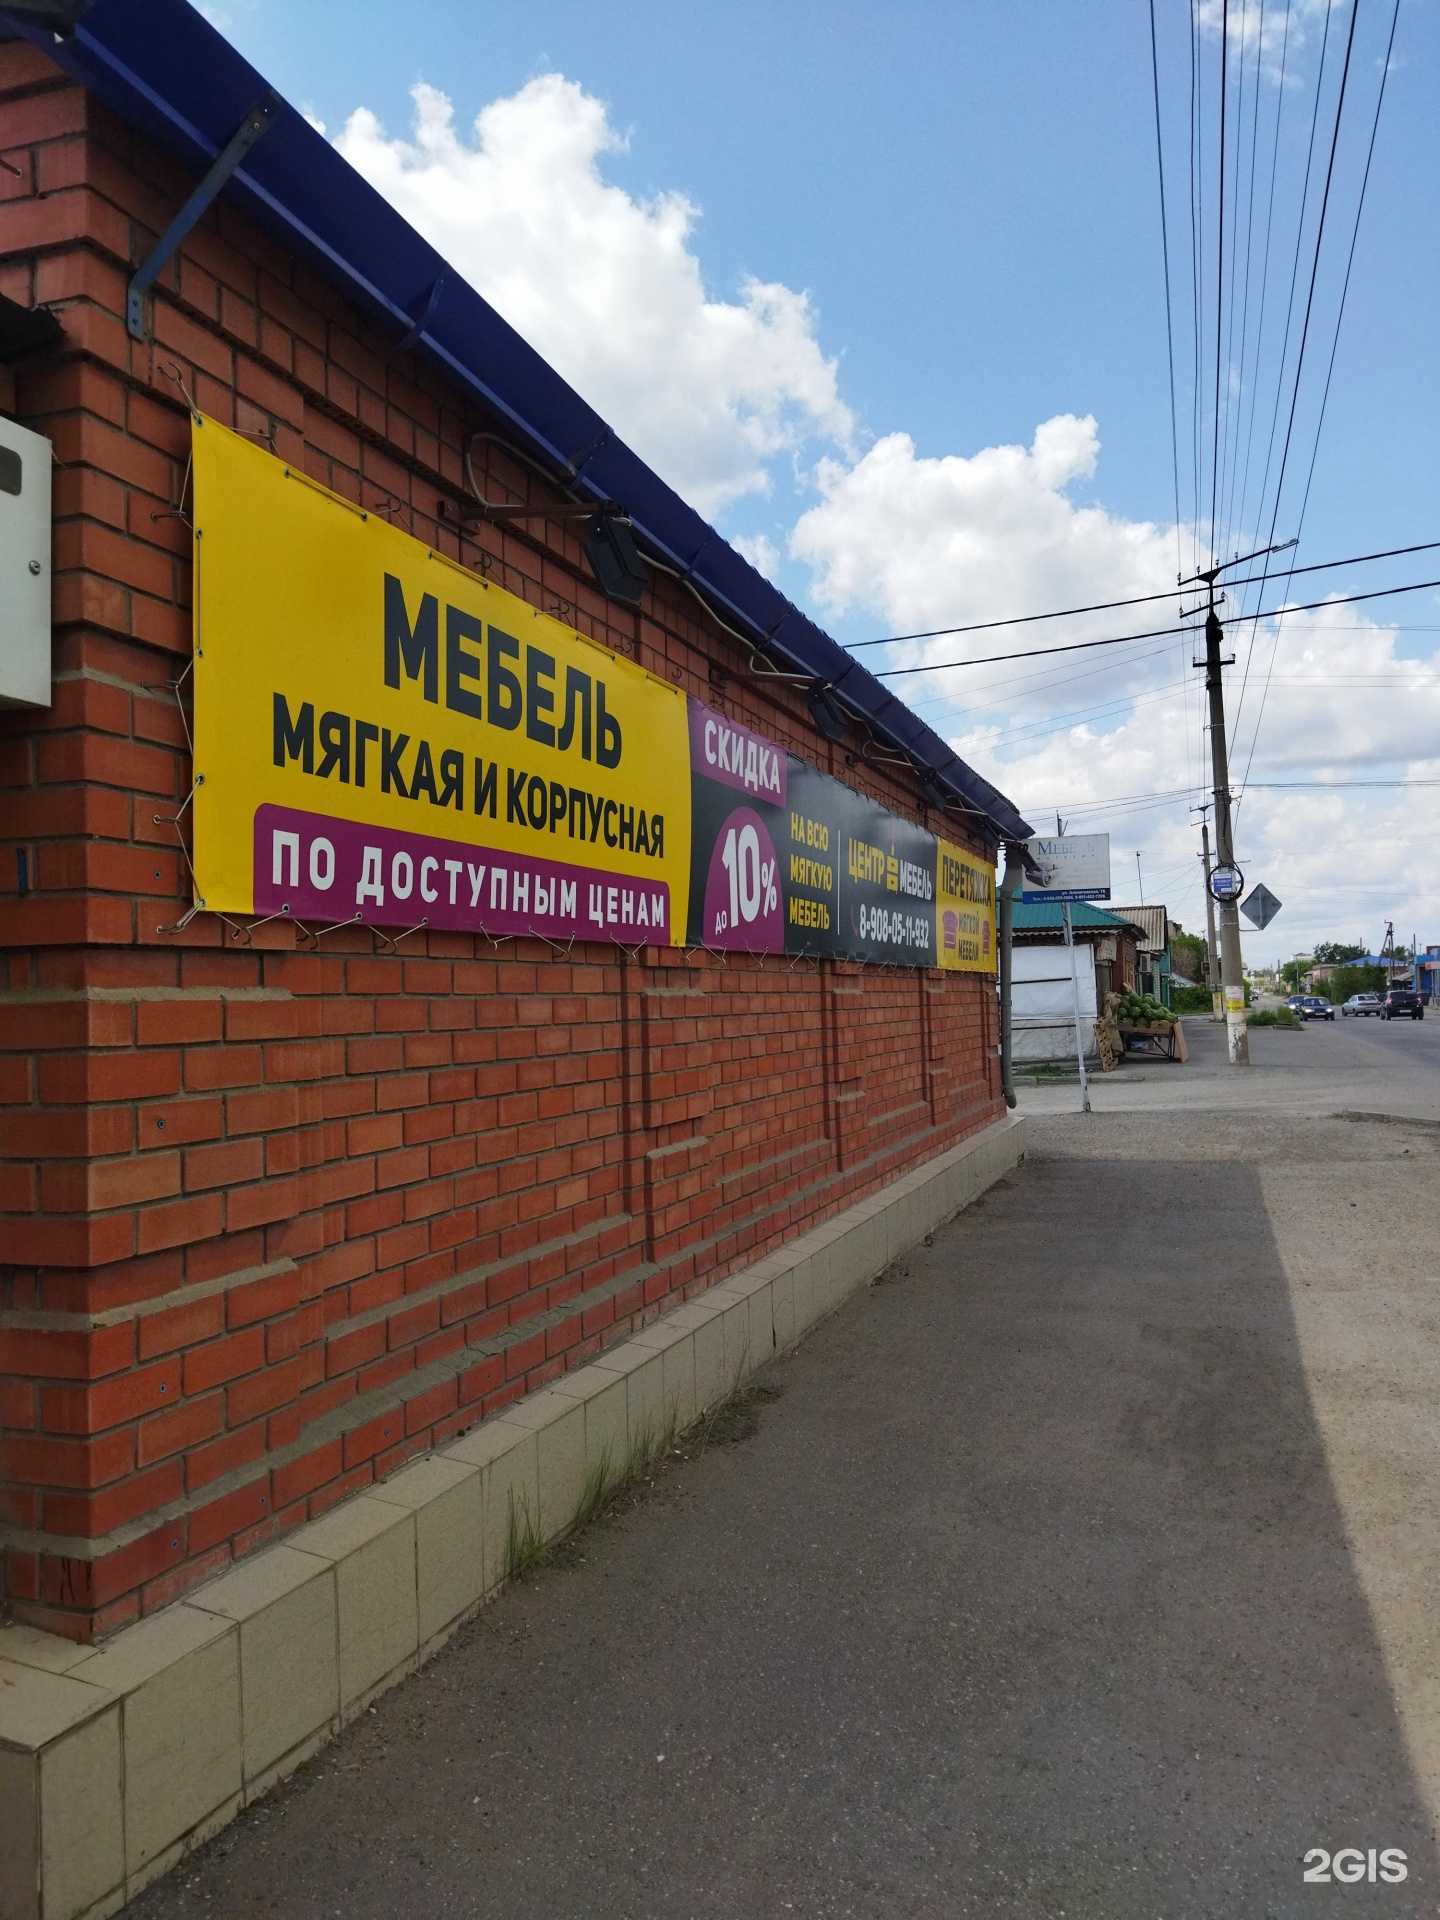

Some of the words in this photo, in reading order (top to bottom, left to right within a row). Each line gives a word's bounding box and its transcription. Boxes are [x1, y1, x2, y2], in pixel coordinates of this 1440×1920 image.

[383, 571, 622, 769] МЕБЕЛЬ
[272, 692, 464, 811] МЯГКАЯ
[474, 757, 497, 819] И
[506, 767, 664, 859] КОРПУСНАЯ
[704, 719, 781, 793] СКИДКА
[790, 812, 805, 845] НА
[806, 819, 829, 852] ВСЮ
[272, 828, 336, 891] ПО
[355, 846, 577, 918] ДОСТУПНЫМ
[588, 883, 665, 928] ЦЕНАМ
[789, 854, 833, 892] МЯГКУЮ
[848, 837, 885, 884] ЦЕНТР
[899, 859, 932, 901] МЕБЕЛЬ
[789, 896, 830, 930] МЕБЕЛЬ
[859, 903, 930, 949] 8-908-05-11-932
